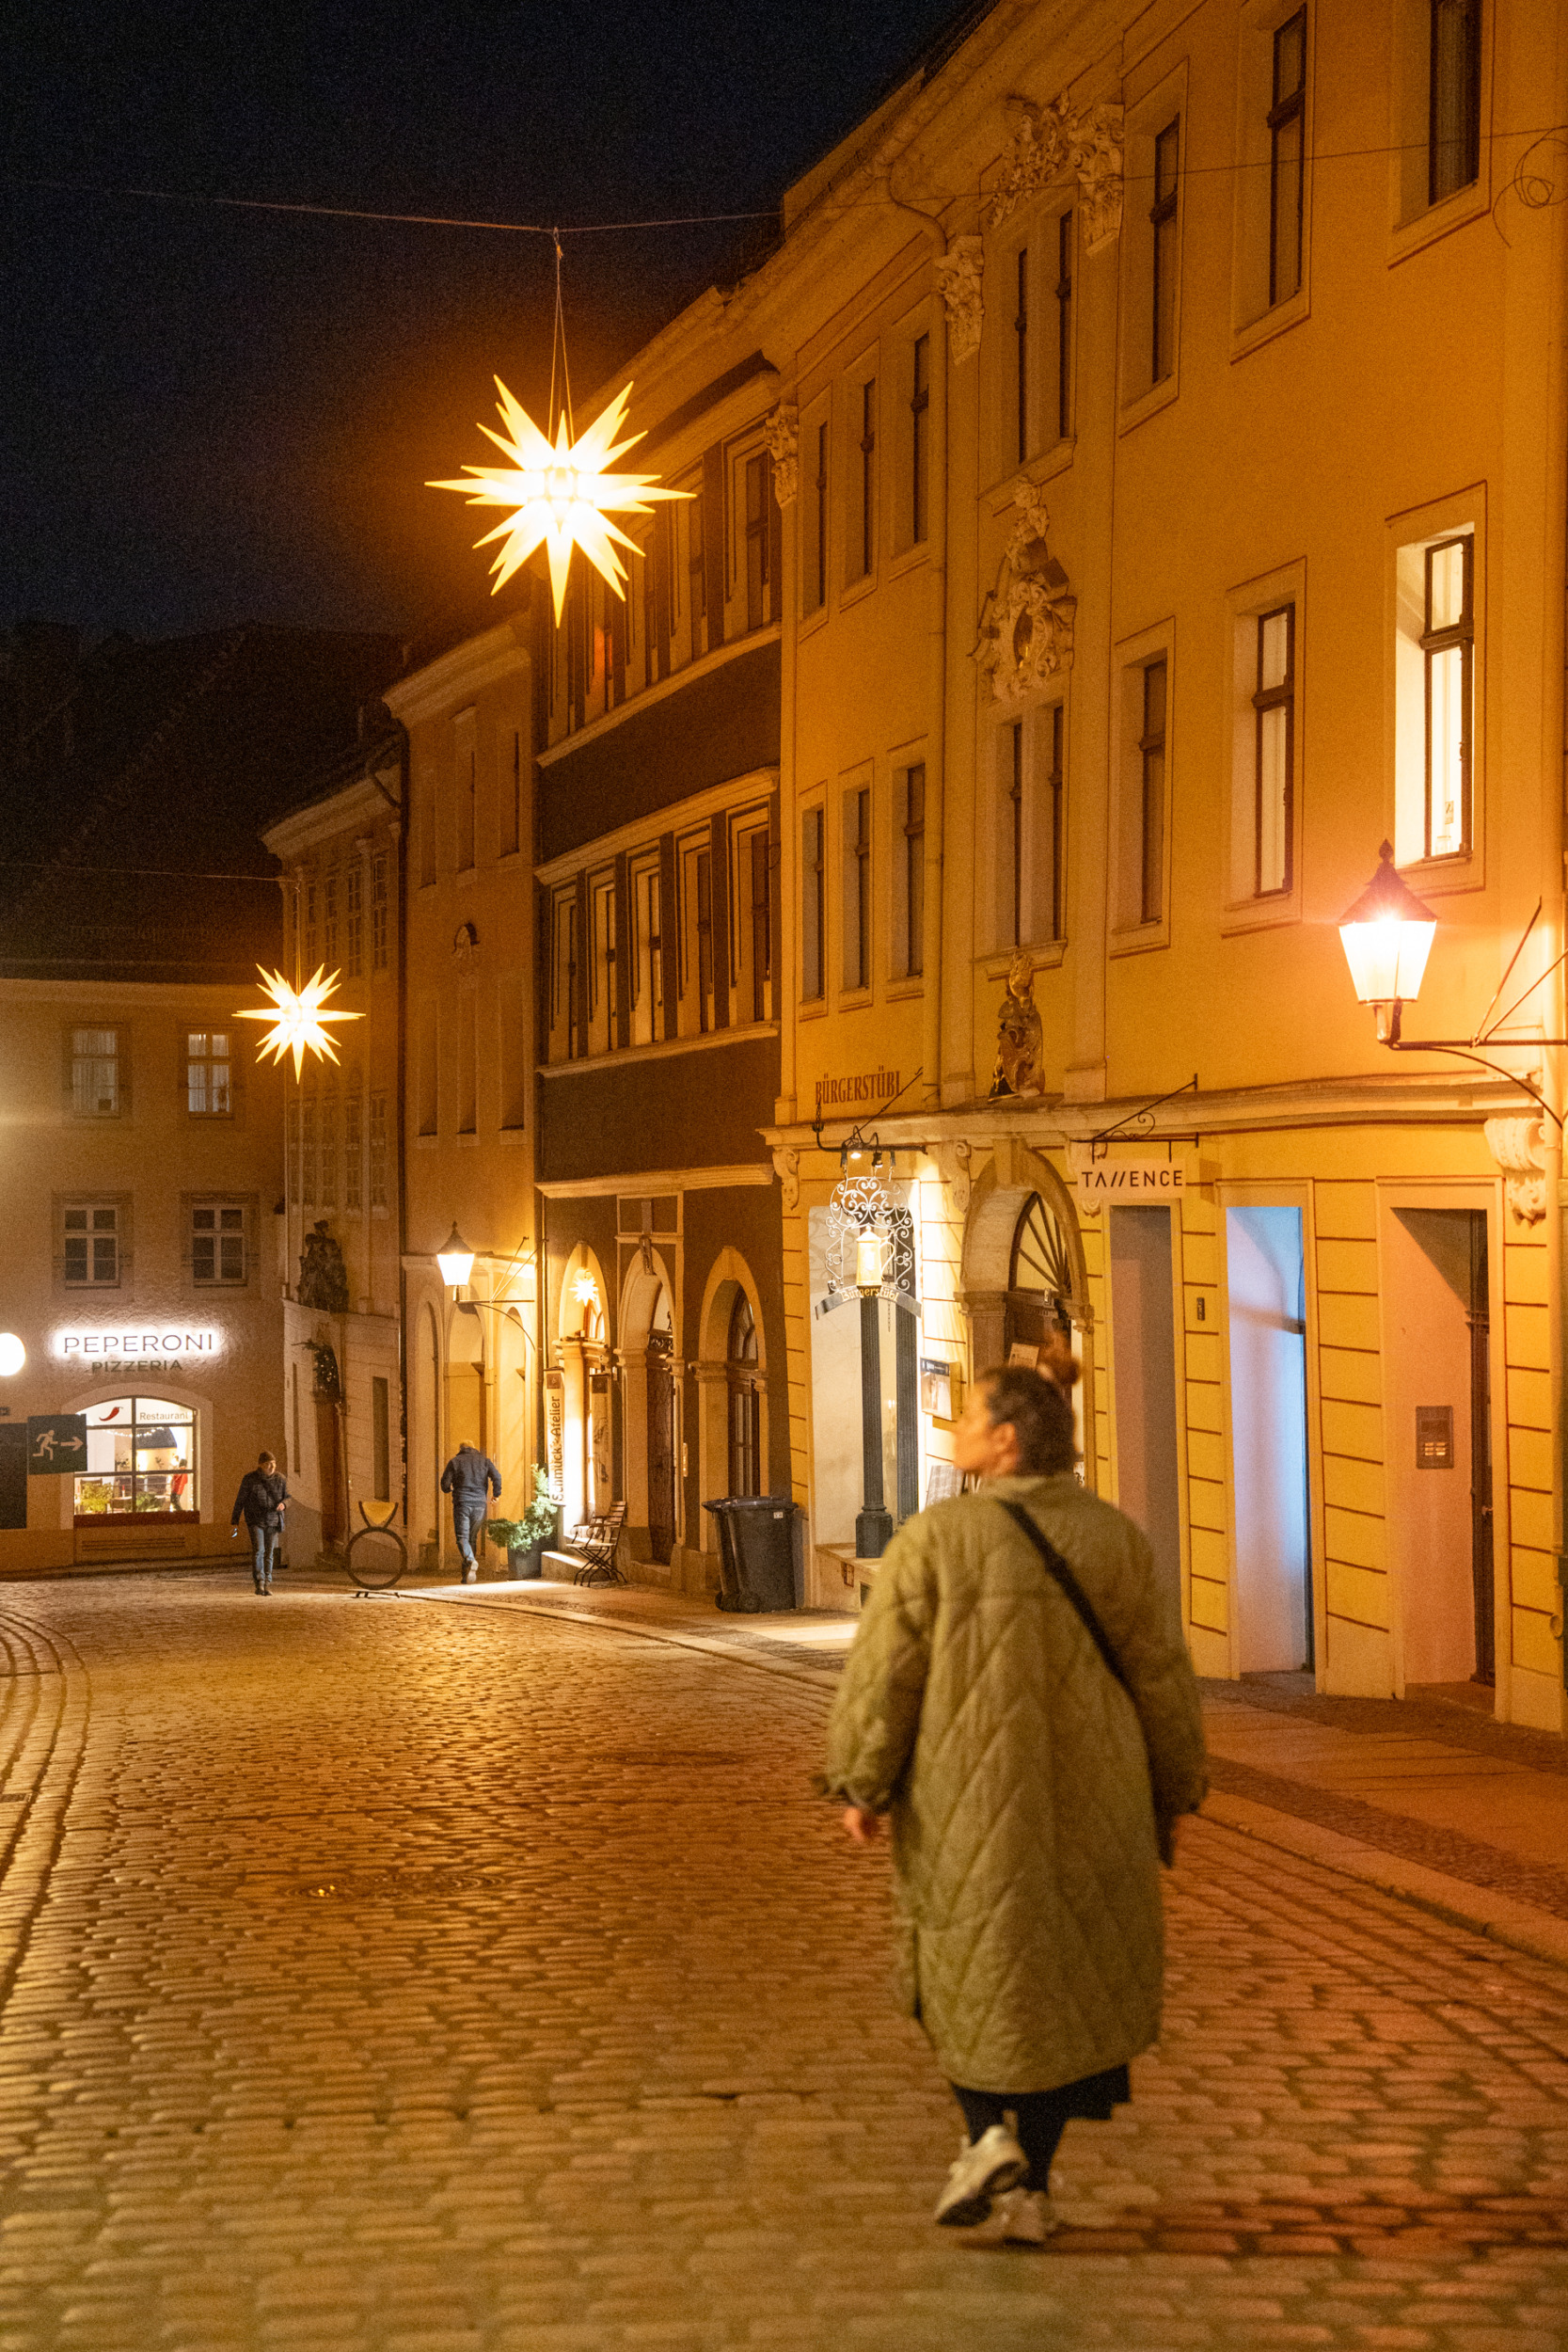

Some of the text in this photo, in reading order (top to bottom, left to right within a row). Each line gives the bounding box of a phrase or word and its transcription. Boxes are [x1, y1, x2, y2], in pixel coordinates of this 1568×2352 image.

[839, 1285, 899, 1302] Bürgerstübl
[63, 1333, 213, 1354] PEPERONI
[91, 1359, 183, 1374] PIZZERIA
[139, 1411, 188, 1421] Restaurant
[549, 1395, 562, 1437] Atelier
